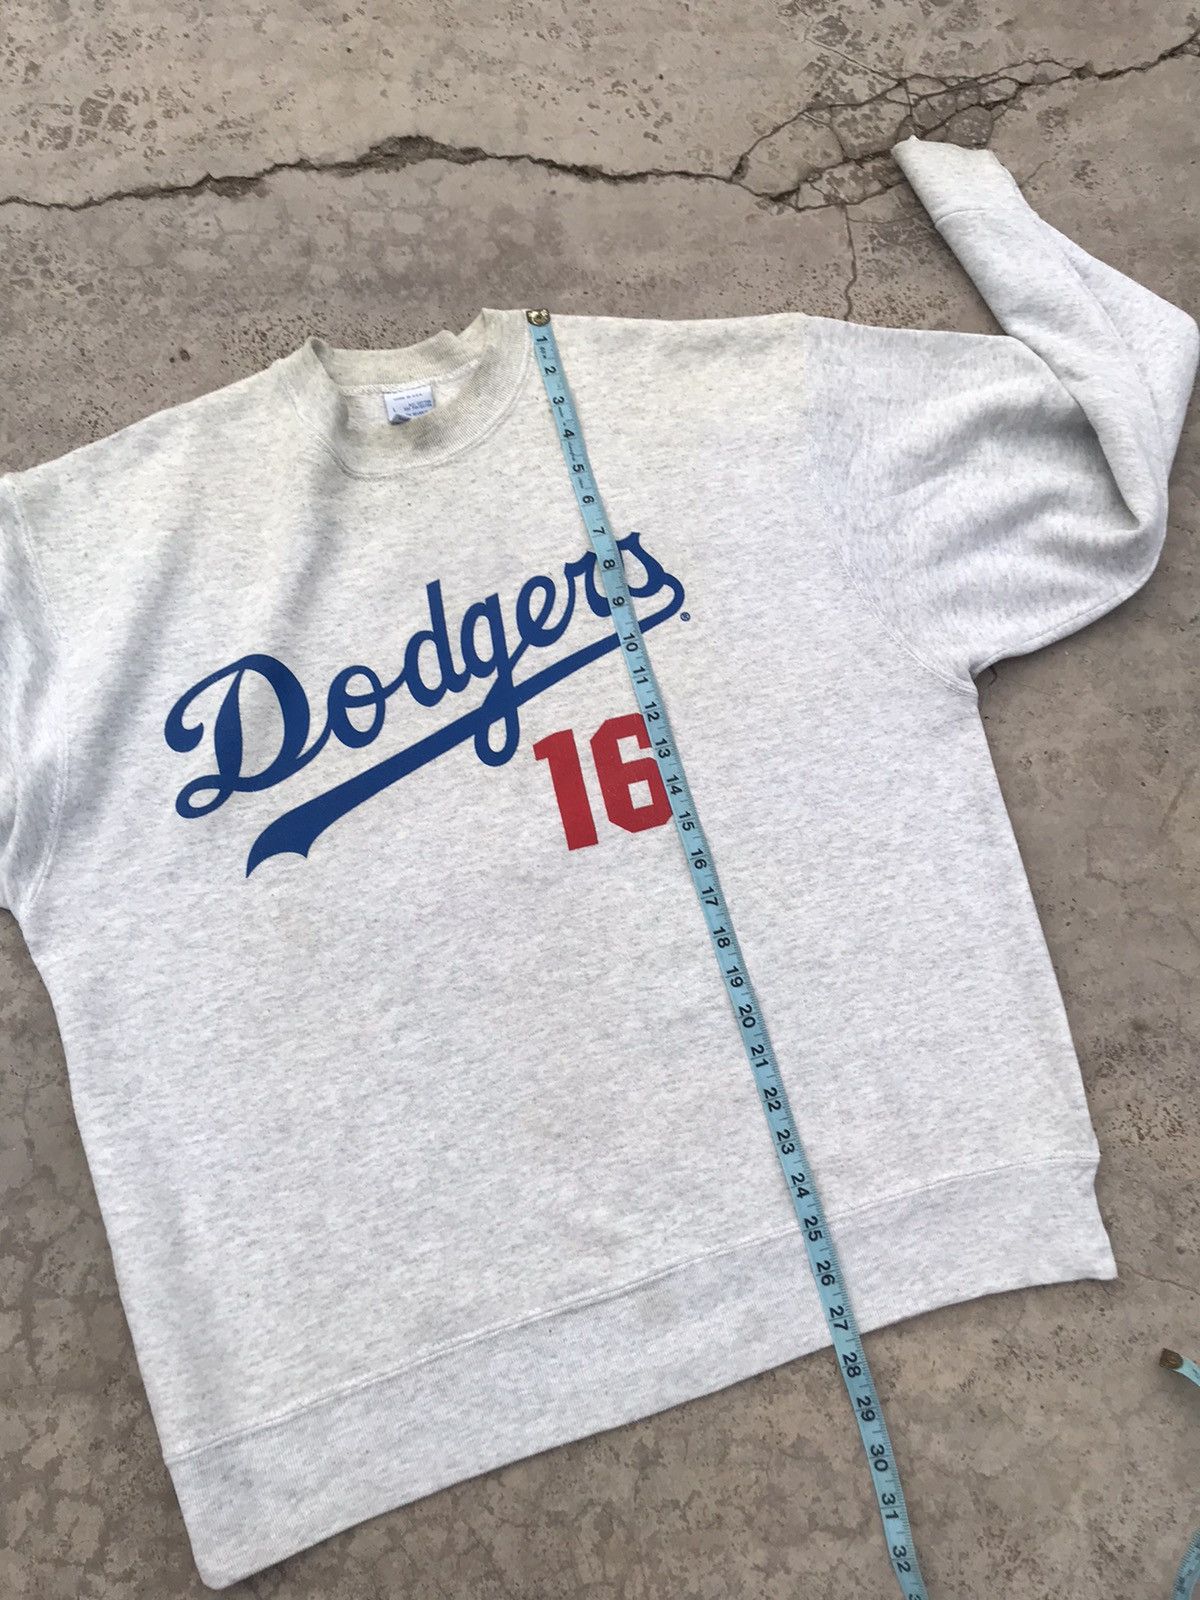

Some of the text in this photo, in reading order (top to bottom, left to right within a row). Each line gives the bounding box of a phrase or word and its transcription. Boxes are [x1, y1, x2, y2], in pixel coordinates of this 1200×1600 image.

[164, 532, 685, 820] Dodgers
[533, 713, 673, 850] 16
[544, 366, 557, 376] 2
[552, 396, 565, 406] 3
[562, 429, 575, 439] 4
[572, 463, 585, 474] 5
[582, 495, 595, 504] 6
[593, 526, 606, 536] 7
[603, 559, 616, 570] 8
[613, 596, 625, 607] 9
[623, 632, 638, 653] 10
[633, 665, 648, 684] 11
[645, 701, 660, 722] 12
[655, 737, 671, 758] 13
[667, 774, 683, 795] 14
[679, 811, 694, 832] 15
[691, 847, 707, 870] 16
[702, 886, 718, 907] 17
[713, 925, 730, 948] 18
[726, 965, 743, 988] 19
[739, 1004, 756, 1029] 20
[751, 1044, 768, 1069] 21
[763, 1087, 781, 1112] 22
[777, 1129, 795, 1155] 23
[791, 1172, 810, 1198] 24
[804, 1216, 823, 1242] 25
[816, 1260, 835, 1286] 26
[829, 1305, 849, 1331] 27
[842, 1352, 862, 1378] 28
[857, 1396, 876, 1422] 29
[870, 1445, 889, 1472] 30
[881, 1492, 899, 1521] 31
[892, 1545, 911, 1573] 32
